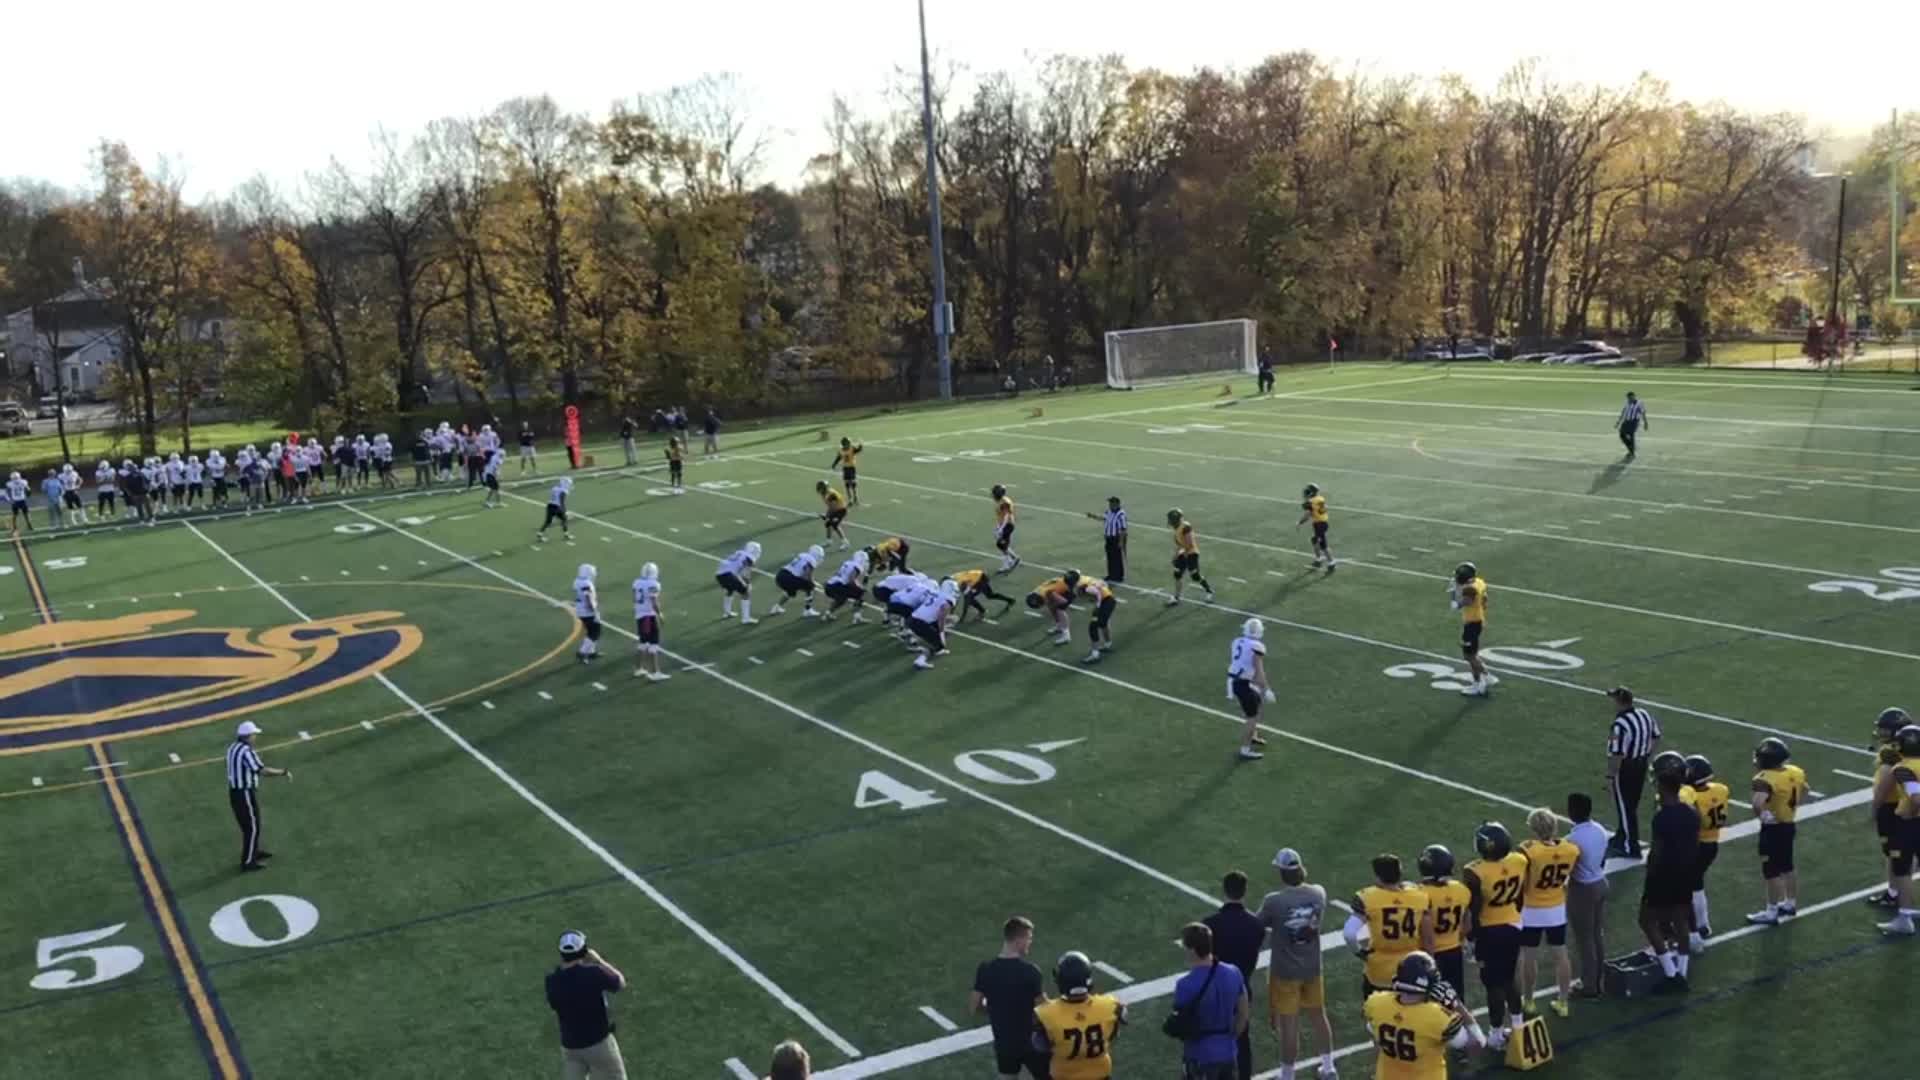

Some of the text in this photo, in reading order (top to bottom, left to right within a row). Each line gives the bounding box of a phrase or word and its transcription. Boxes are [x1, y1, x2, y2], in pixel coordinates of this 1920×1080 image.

[854, 749, 1056, 810] 40
[1488, 876, 1521, 906] 22
[1536, 863, 1570, 889] 85
[1381, 906, 1416, 940] 54
[1435, 905, 1461, 934] 51
[29, 894, 319, 989] 50
[1063, 1024, 1105, 1060] 78
[1522, 1018, 1551, 1063] 40
